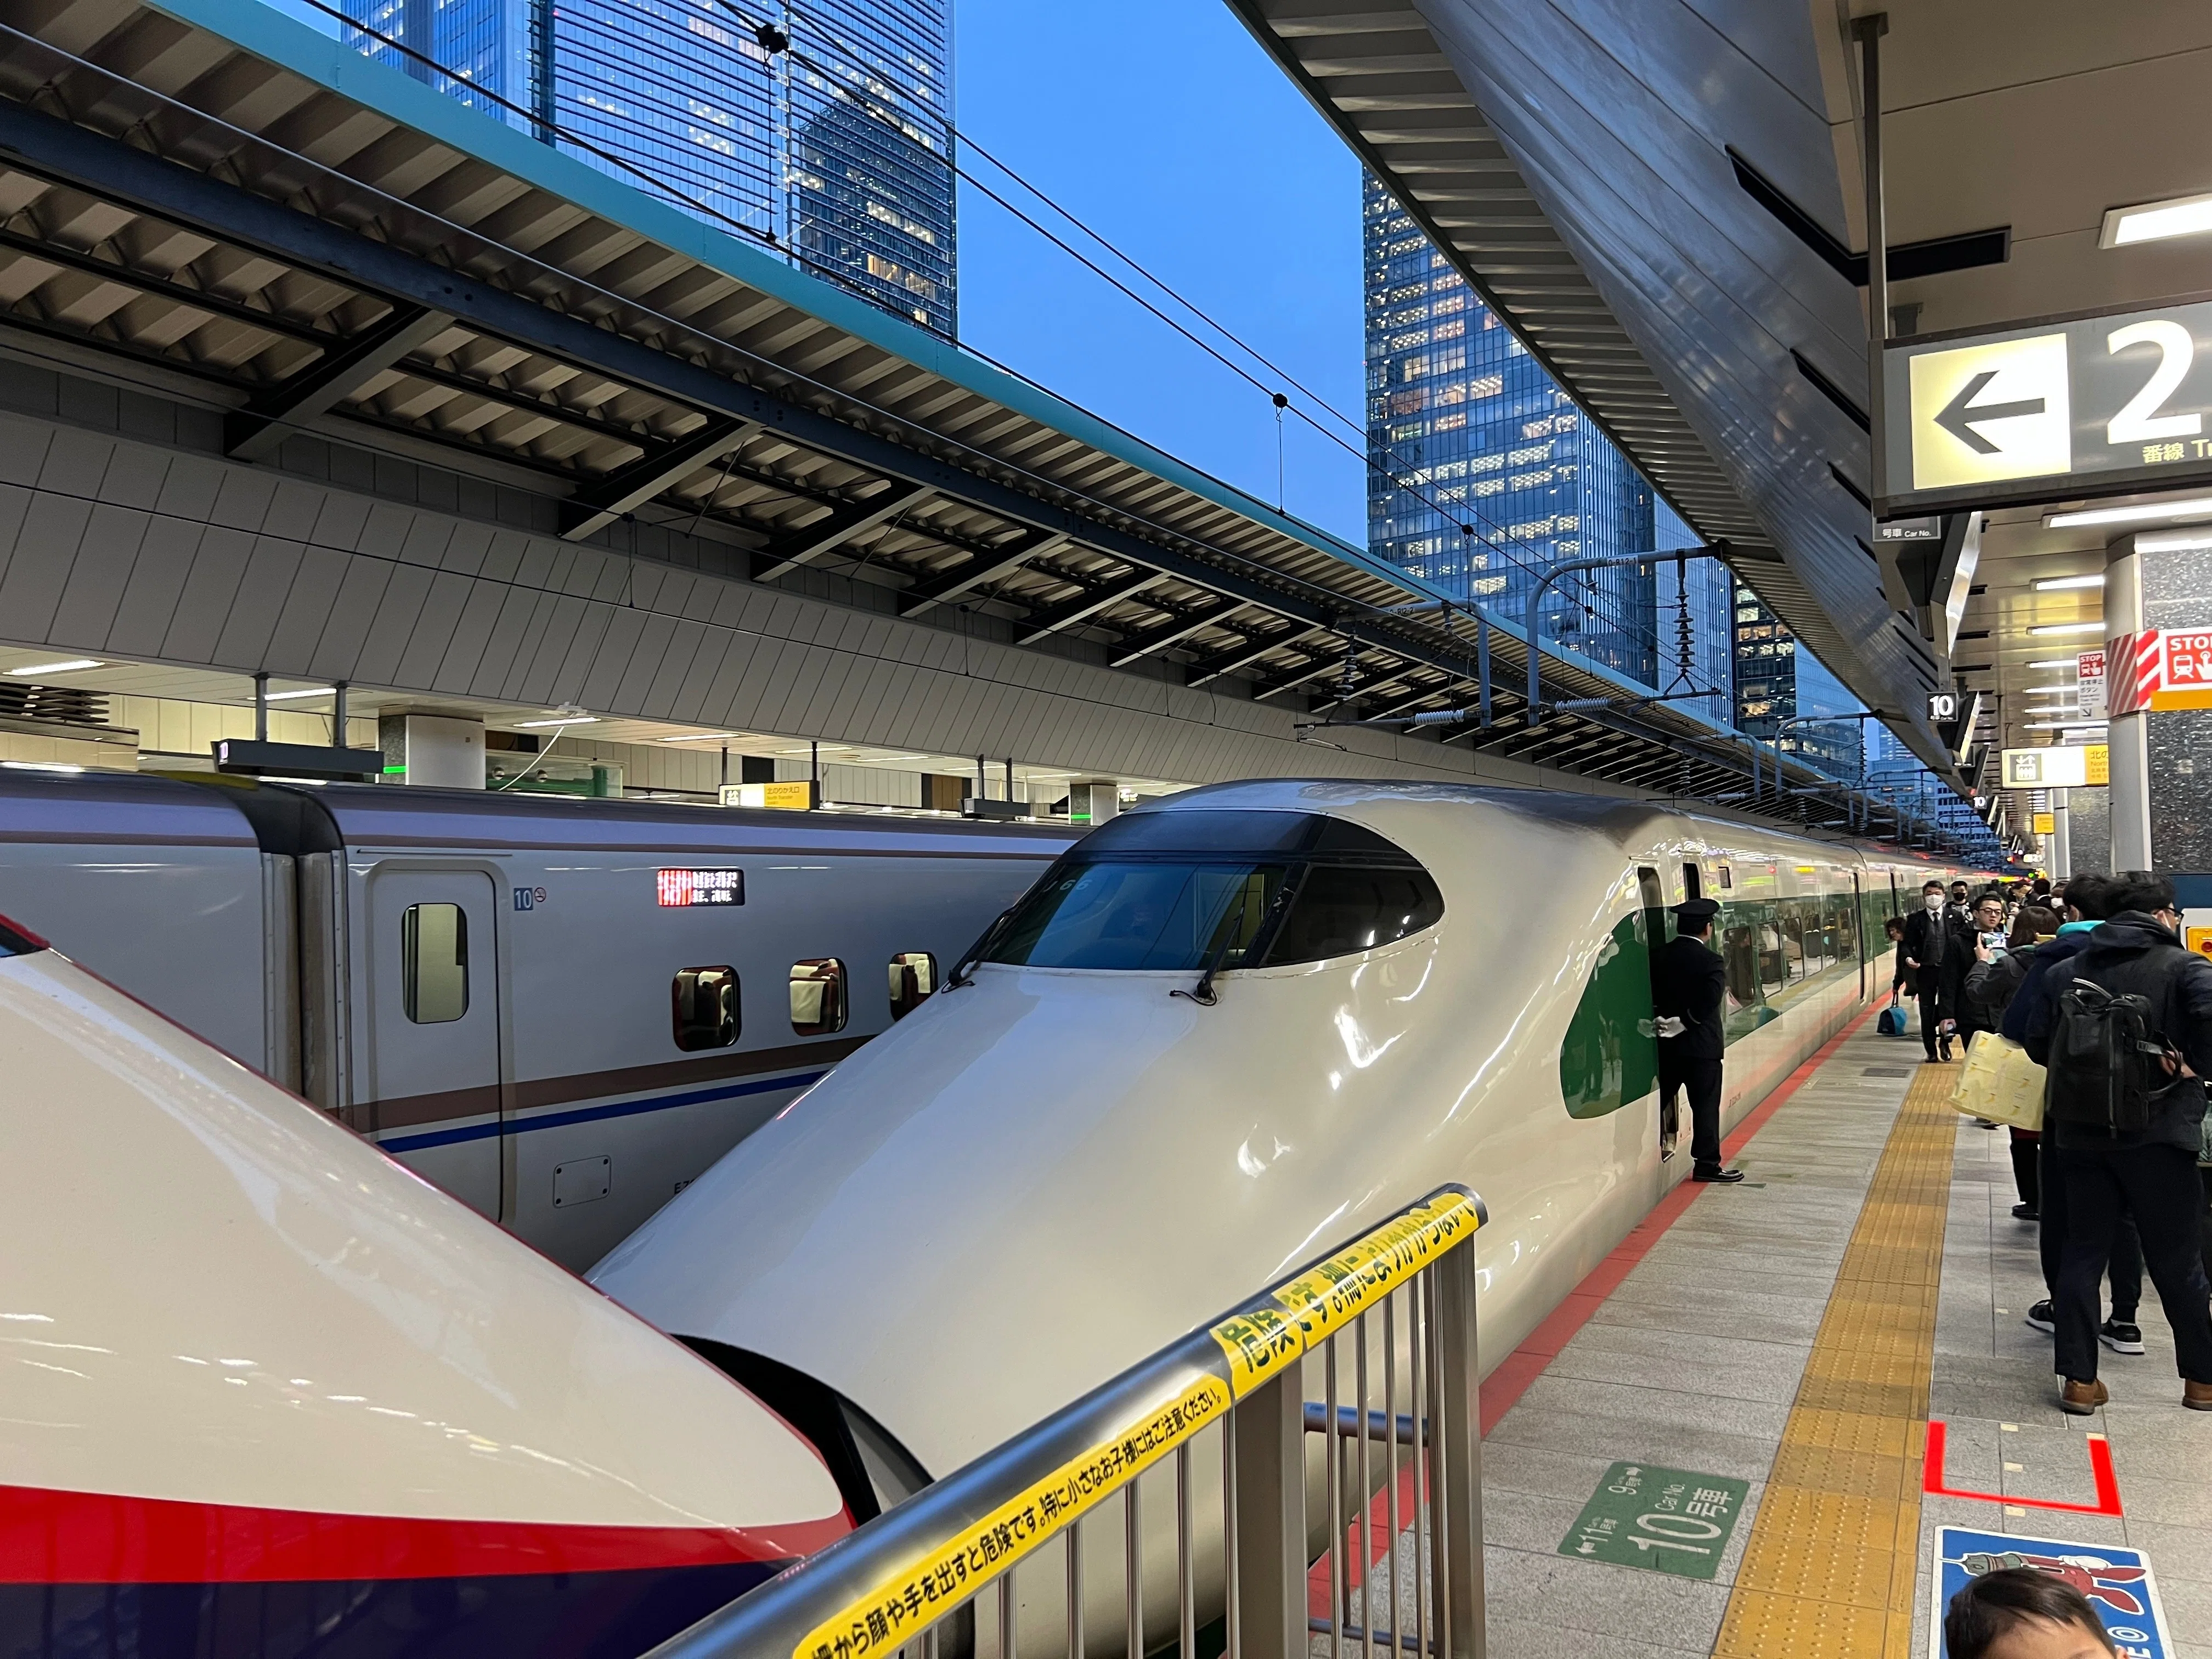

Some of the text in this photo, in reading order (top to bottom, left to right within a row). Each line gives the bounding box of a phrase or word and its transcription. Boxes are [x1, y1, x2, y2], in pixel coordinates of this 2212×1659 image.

[2107, 320, 2202, 444] 2
[2142, 442, 2185, 464] 番線
[1882, 528, 1902, 538] 号車
[2170, 635, 2212, 652] STO
[2080, 654, 2102, 663] STOP
[1929, 695, 1954, 716] 10
[767, 786, 800, 794] 北のりかえ口
[1973, 796, 1986, 807] 10
[515, 889, 532, 909] 10
[1608, 1485, 1637, 1495] 9
[1655, 1483, 1686, 1511] Car No.
[1627, 1487, 1733, 1554] 10 号車
[1578, 1527, 1613, 1542] 11
